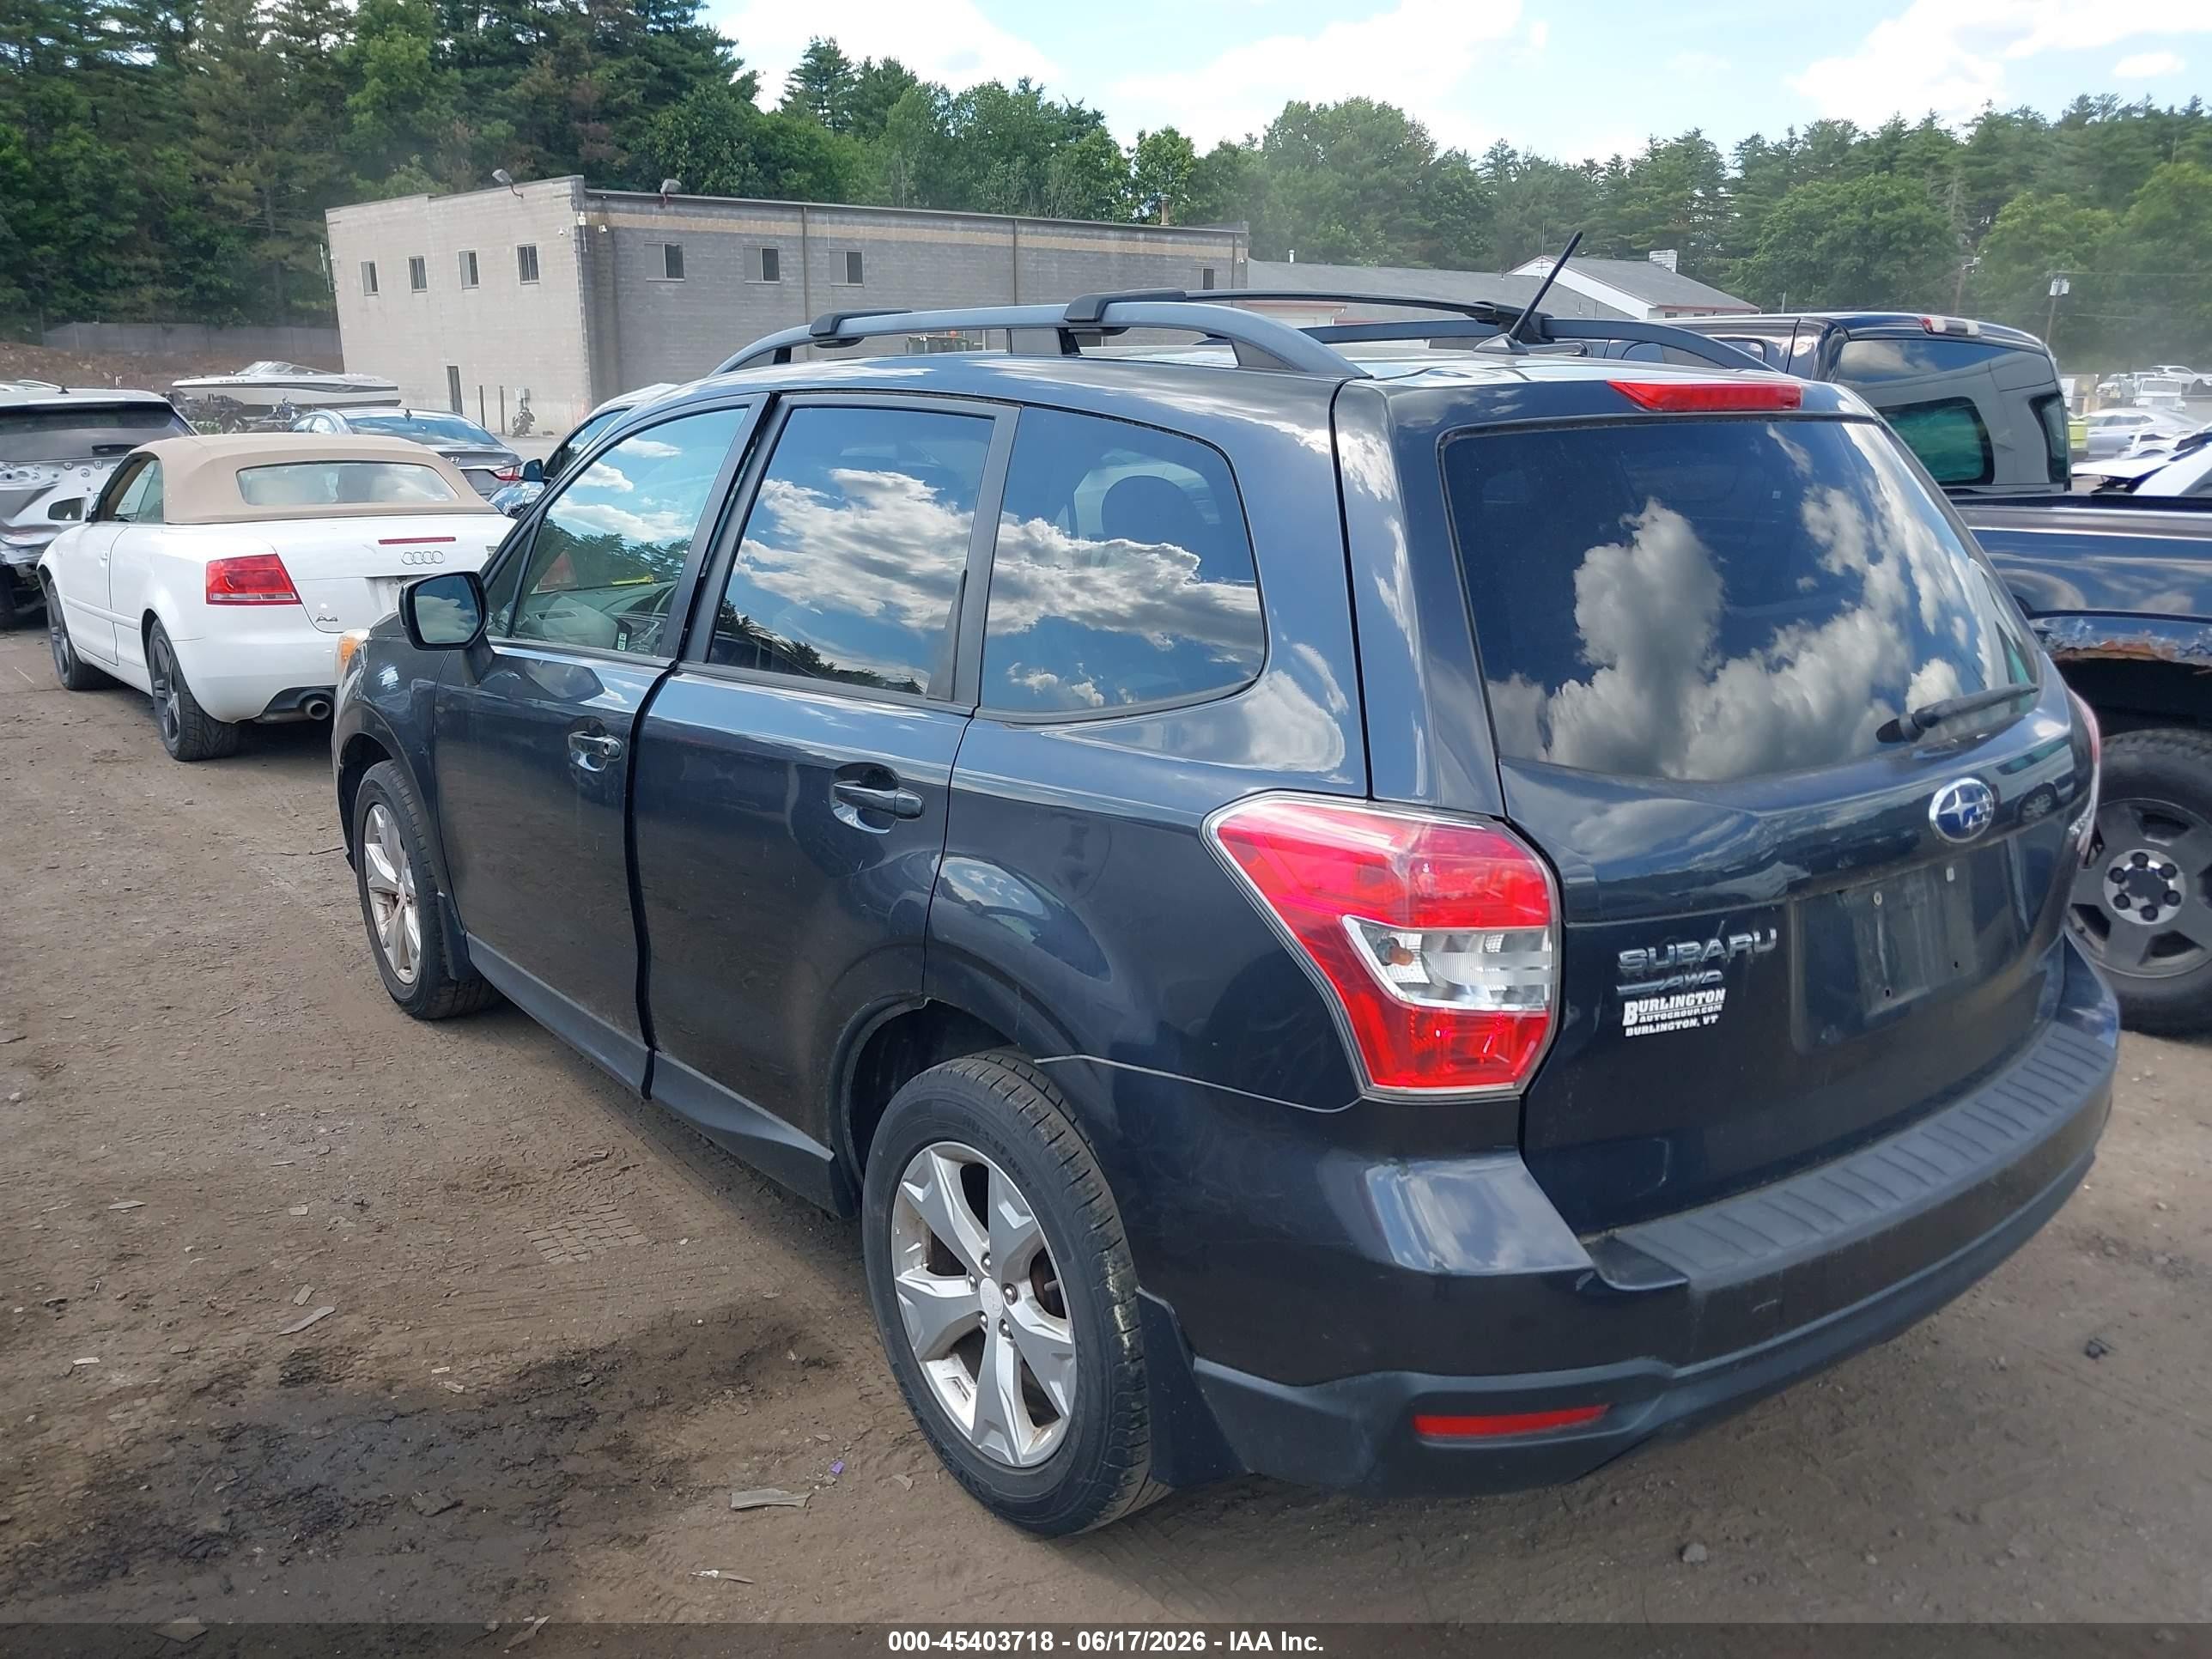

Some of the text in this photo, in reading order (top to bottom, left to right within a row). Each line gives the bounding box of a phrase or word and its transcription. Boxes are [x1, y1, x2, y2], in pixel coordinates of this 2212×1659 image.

[1617, 927, 1778, 969] SUBARU
[1658, 969, 1724, 992] AWD
[1622, 988, 1727, 1026] BURLINGTON
[1638, 1004, 1723, 1024] AUTOGROUP.COM
[1702, 1013, 1719, 1025] VT
